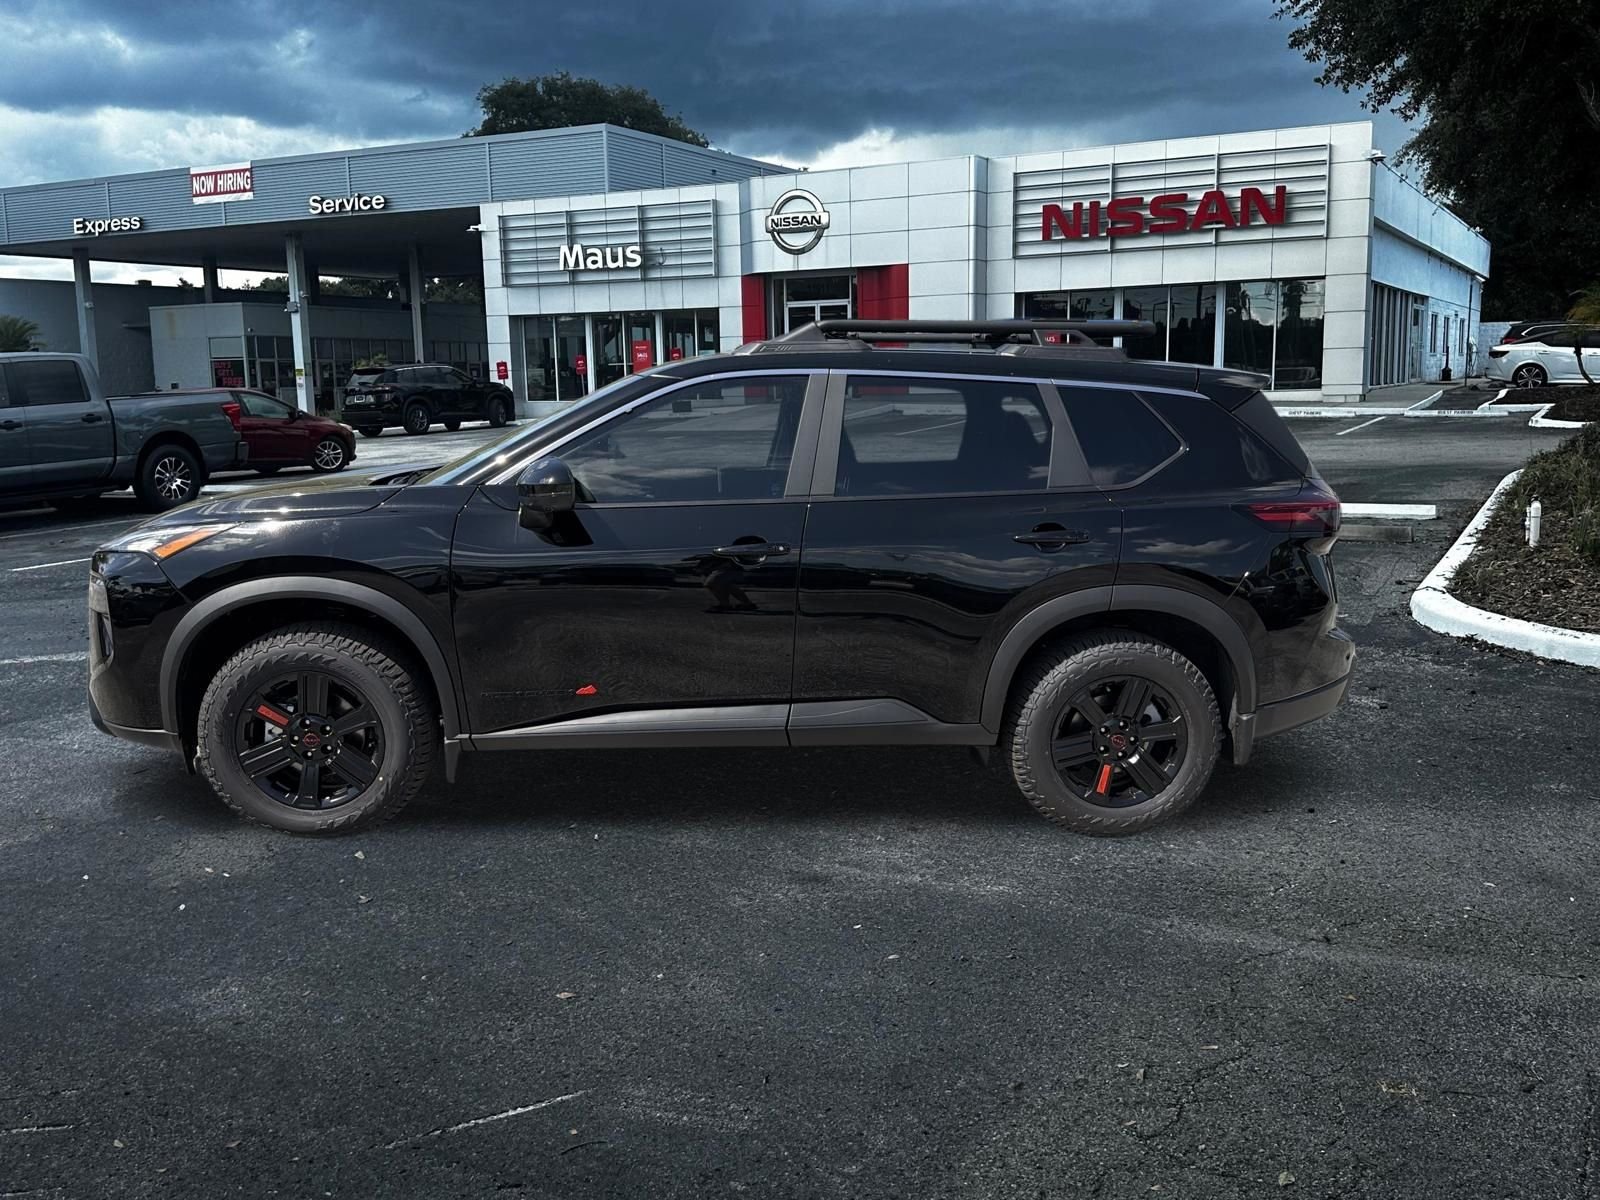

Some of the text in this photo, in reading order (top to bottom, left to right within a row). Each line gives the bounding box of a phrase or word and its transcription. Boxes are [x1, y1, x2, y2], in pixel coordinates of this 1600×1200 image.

[192, 171, 251, 195] NOW HIRING
[309, 193, 385, 214] Service
[1042, 185, 1287, 241] NISSAN
[73, 216, 141, 237] Express
[770, 214, 822, 228] NISSAN
[559, 243, 642, 271] Maus
